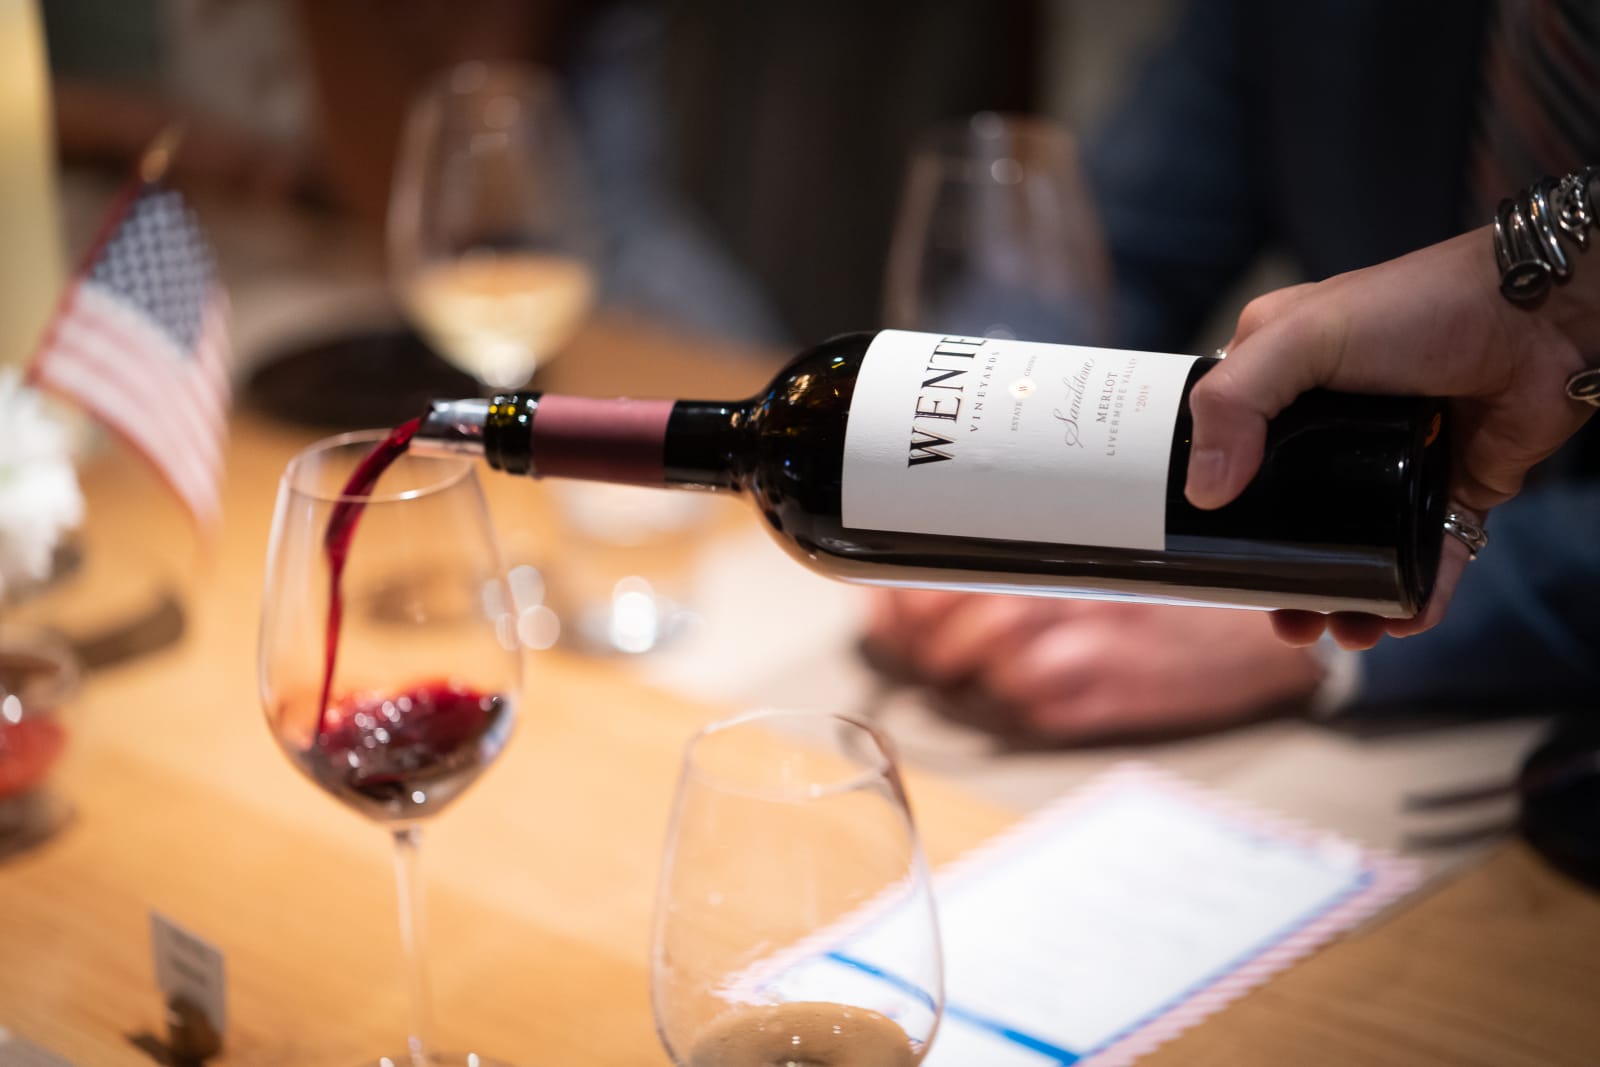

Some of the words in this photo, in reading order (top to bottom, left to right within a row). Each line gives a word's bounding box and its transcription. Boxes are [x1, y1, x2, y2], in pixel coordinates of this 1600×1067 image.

[907, 337, 988, 469] WENTE
[969, 351, 1000, 433] VINEYARDS
[1010, 401, 1023, 432] ESTATE
[1051, 357, 1096, 449] Sandstone
[1095, 371, 1119, 424] MERLOT
[1105, 387, 1128, 457] LIVERMORE
